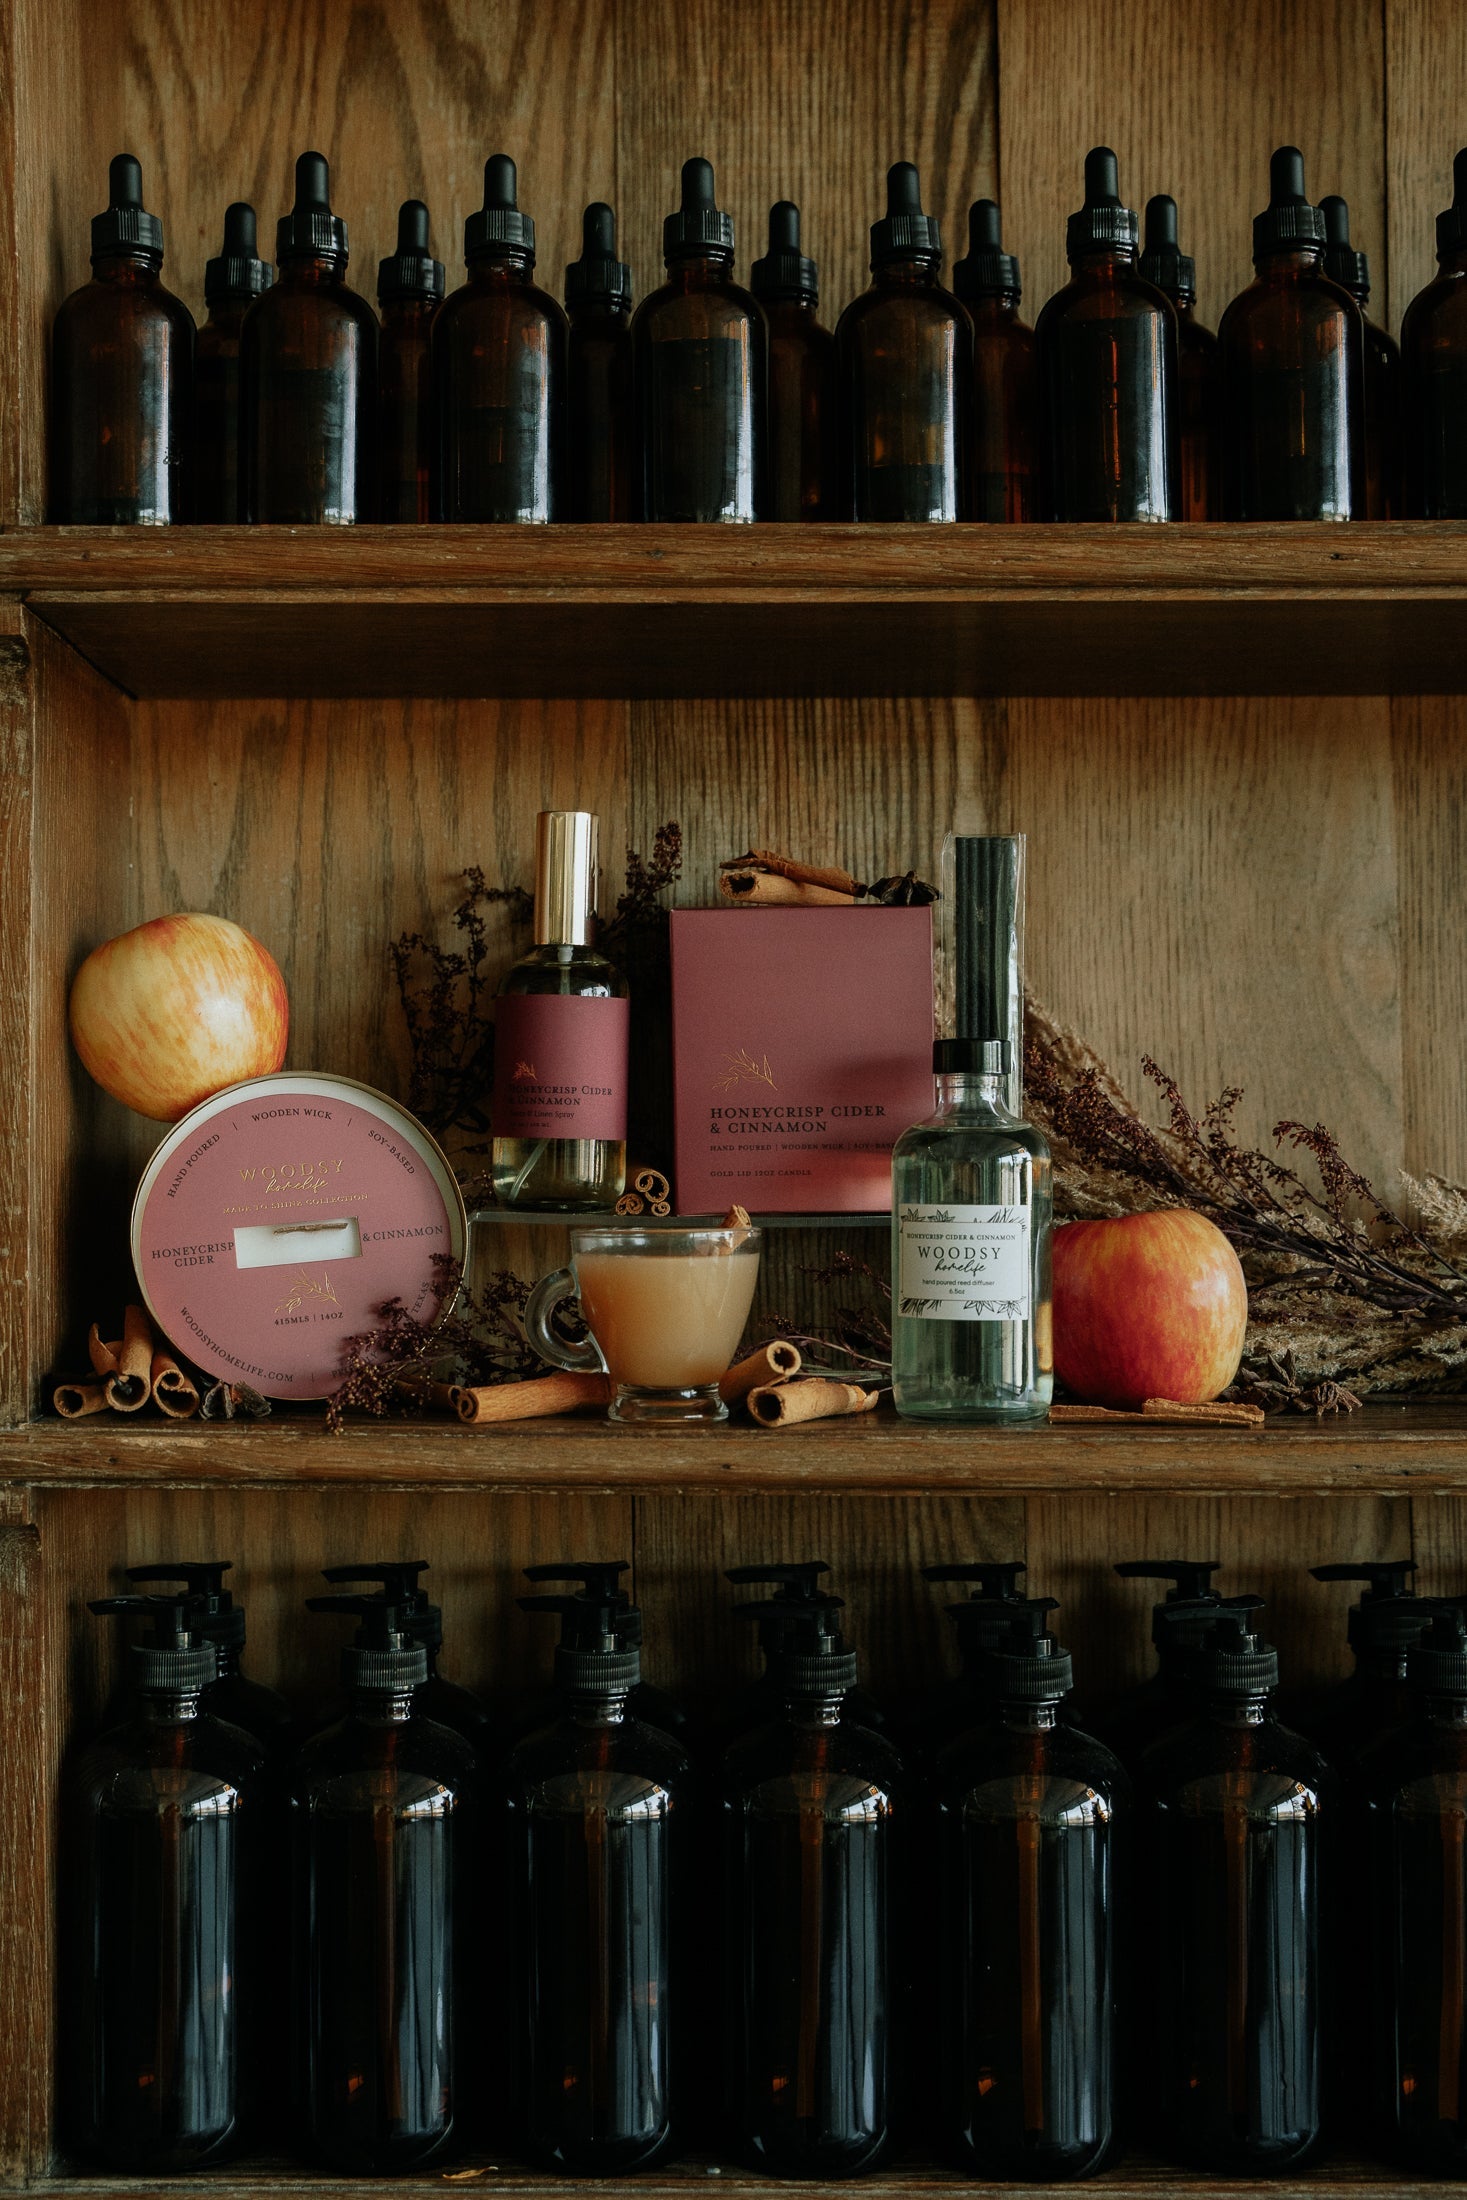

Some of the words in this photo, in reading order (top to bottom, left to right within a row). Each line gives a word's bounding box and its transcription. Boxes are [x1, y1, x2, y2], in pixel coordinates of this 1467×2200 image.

[251, 1108, 300, 1122] WOODEN
[303, 1108, 332, 1120] WICK
[554, 1111, 575, 1120] Spray
[710, 1107, 824, 1119] HONEYCRISP
[831, 1105, 886, 1118] CIDER
[710, 1123, 721, 1134] &
[728, 1121, 827, 1134] CINNAMON
[368, 1129, 415, 1175] SOY-BASED
[738, 1144, 772, 1152] POURED
[781, 1143, 819, 1151] WOODEN
[167, 1168, 187, 1198] HAND
[185, 1134, 220, 1167] POURED
[239, 1159, 344, 1182] WOODSY
[305, 1193, 369, 1206] COLLECTION
[362, 1232, 371, 1241] &
[373, 1225, 444, 1242] CINNAMON
[906, 1232, 943, 1240] HONEYCRISP
[945, 1233, 967, 1241] CIDER
[151, 1242, 234, 1259] HONEYCRISP
[917, 1245, 1002, 1260] WOODSY
[174, 1255, 215, 1268] CIDER
[934, 1258, 987, 1277] homelife
[936, 1279, 957, 1287] poured
[410, 1281, 430, 1314] TEXAS
[274, 1314, 310, 1326] 415MLS
[180, 1306, 294, 1382] WOODSYHOMELIFE.COM
